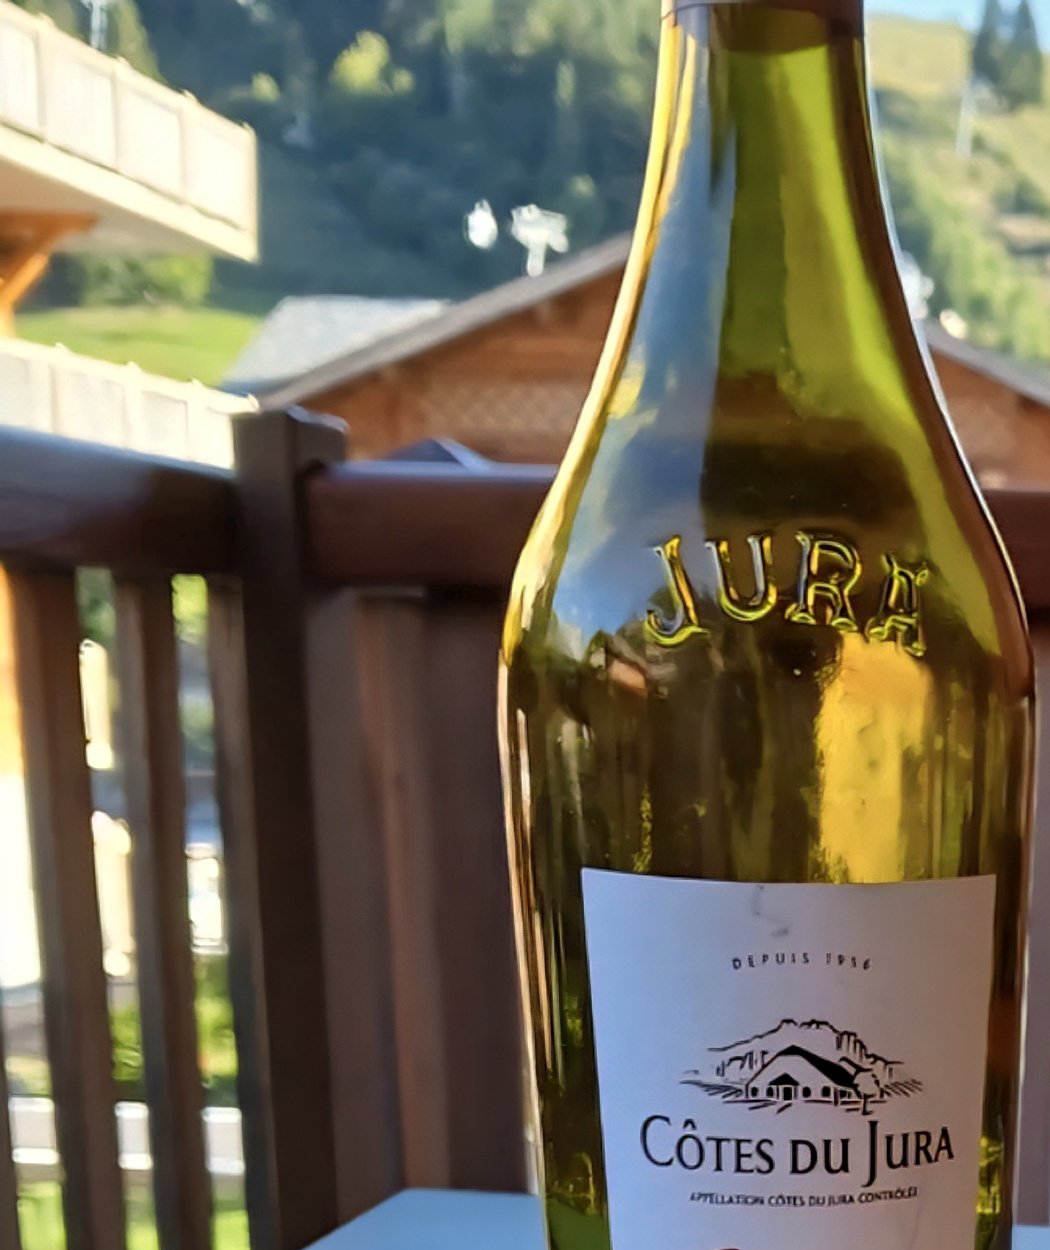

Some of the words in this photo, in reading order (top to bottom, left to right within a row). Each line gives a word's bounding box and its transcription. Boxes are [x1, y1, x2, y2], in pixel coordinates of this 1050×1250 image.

[644, 530, 930, 657] JURA
[731, 952, 810, 970] DEPUIS
[640, 1114, 775, 1175] CÔTES
[789, 1138, 850, 1175] DU
[861, 1120, 955, 1188] JURA
